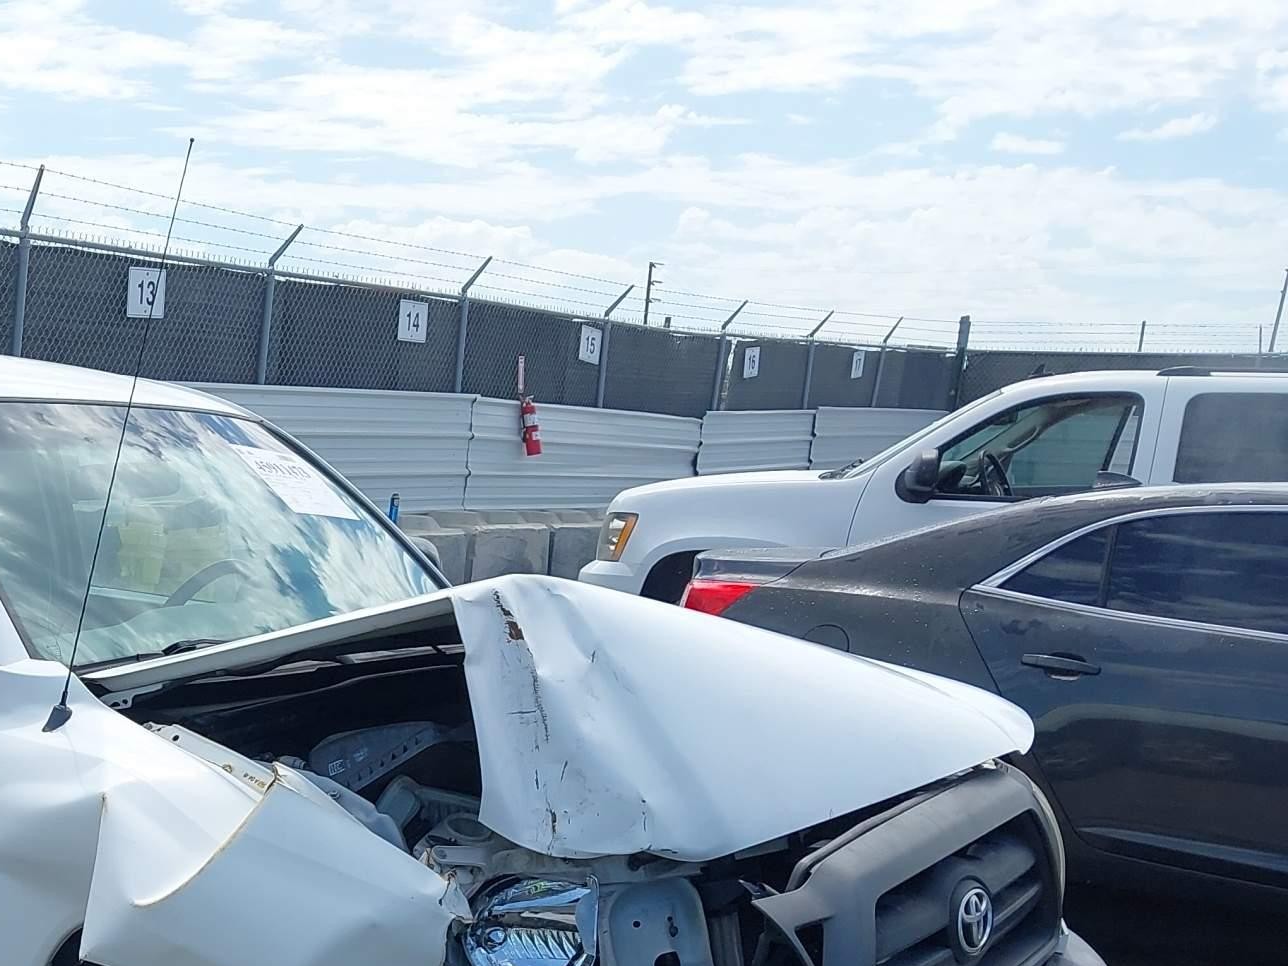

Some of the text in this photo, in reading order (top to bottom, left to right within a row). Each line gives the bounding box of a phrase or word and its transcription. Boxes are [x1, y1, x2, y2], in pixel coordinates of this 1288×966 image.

[137, 279, 156, 306] 13
[406, 311, 420, 332] 14
[585, 335, 596, 354] 15
[748, 354, 756, 370] 16
[855, 358, 862, 371] 17
